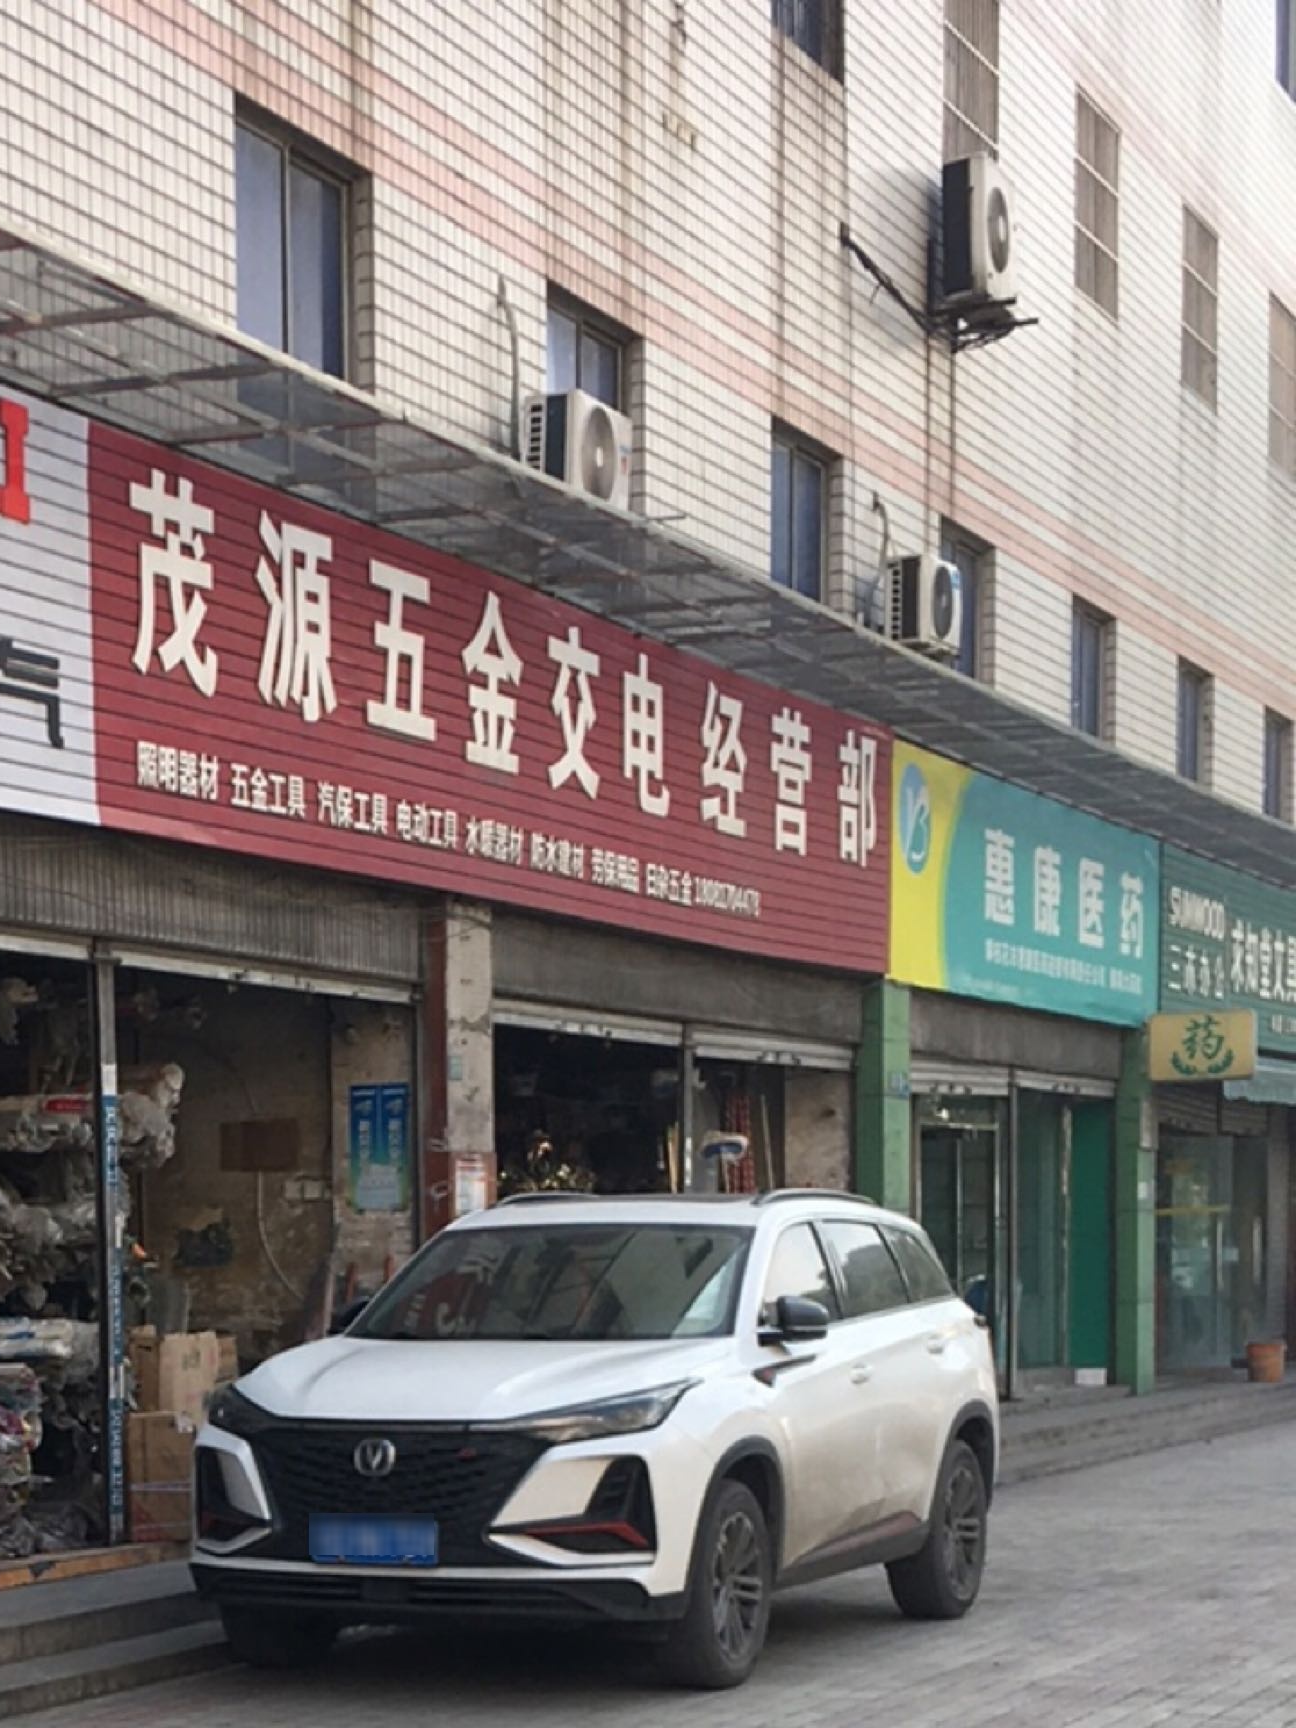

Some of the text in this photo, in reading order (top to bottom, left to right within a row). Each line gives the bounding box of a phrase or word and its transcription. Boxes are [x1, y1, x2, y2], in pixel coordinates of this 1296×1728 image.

[129, 468, 878, 868] 茂源五金交电经营部
[136, 740, 219, 800] 照明器材
[230, 763, 306, 818] 五金工具
[317, 781, 388, 835] 汽保工具
[396, 799, 458, 849] 电动工具
[1182, 1015, 1225, 1061] 药
